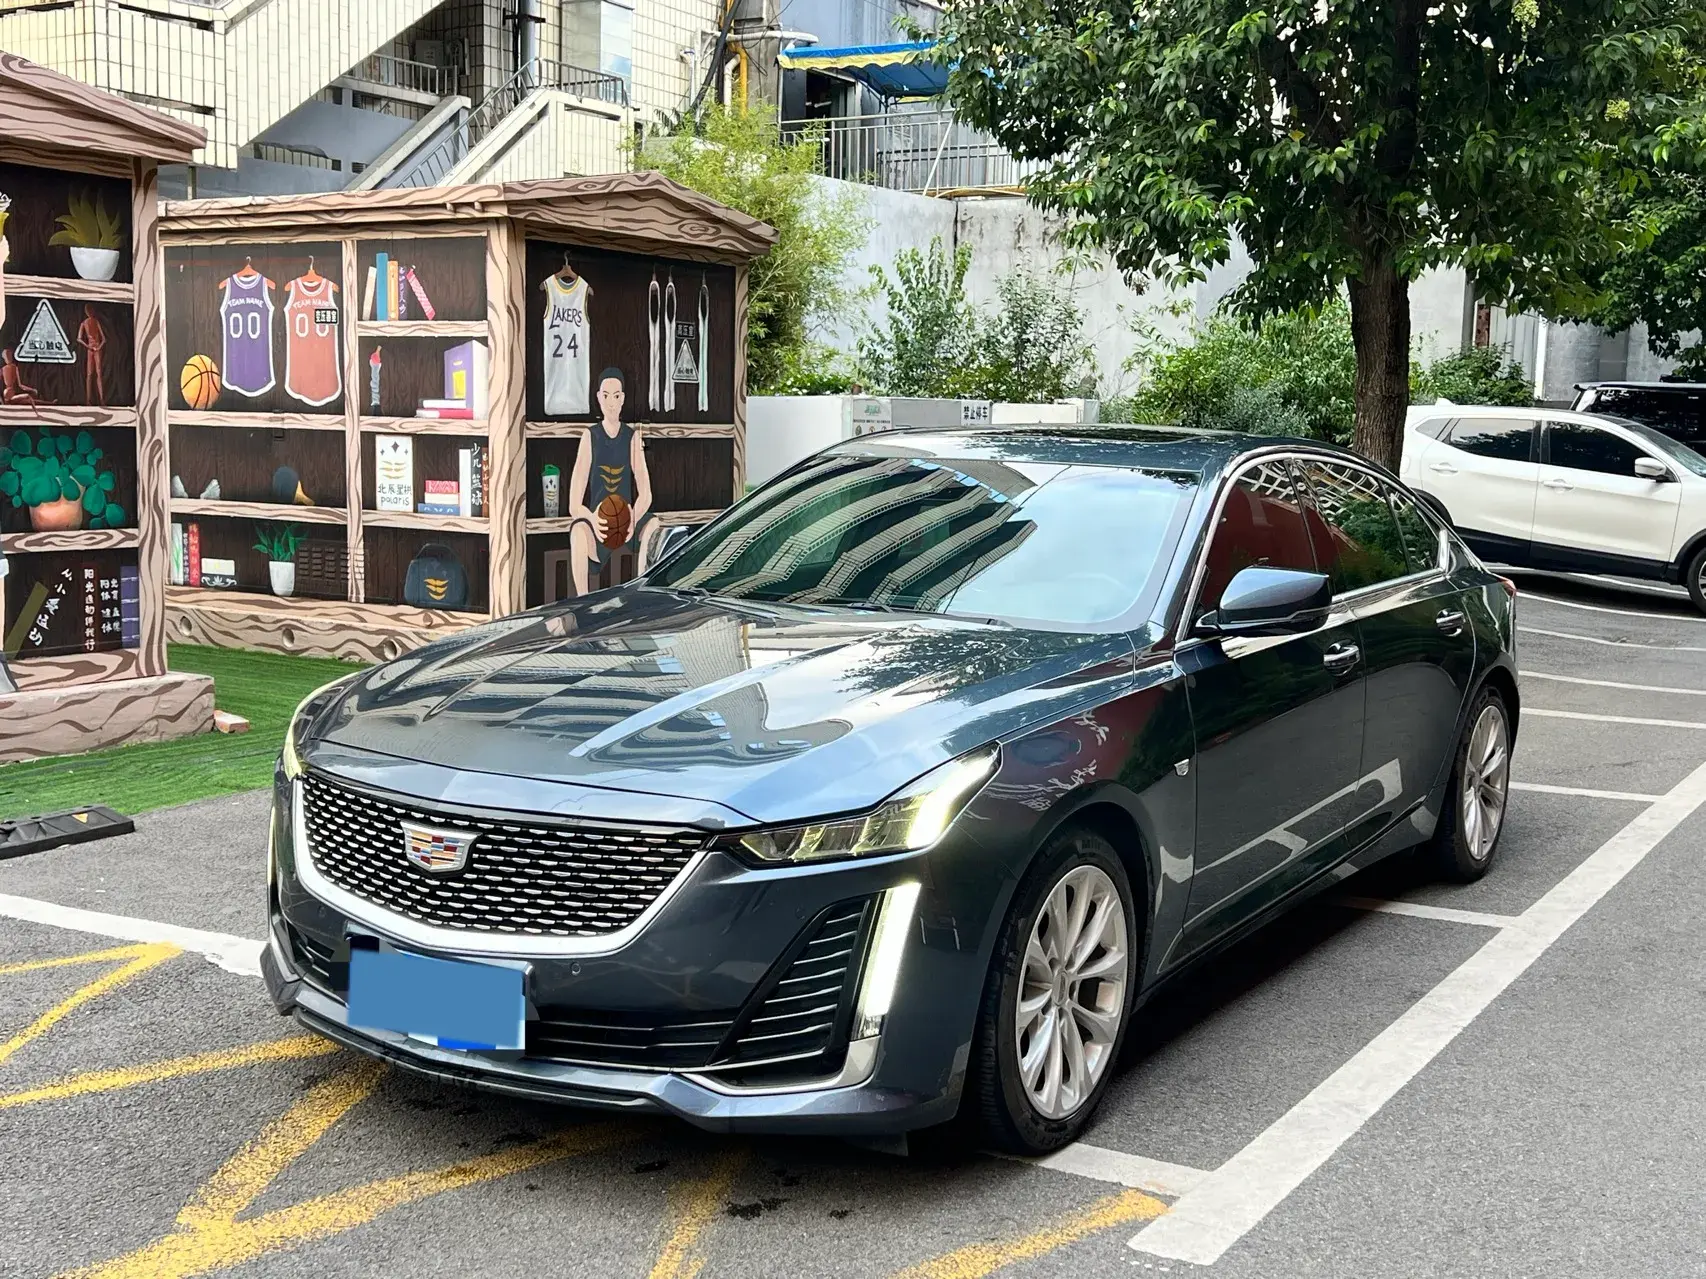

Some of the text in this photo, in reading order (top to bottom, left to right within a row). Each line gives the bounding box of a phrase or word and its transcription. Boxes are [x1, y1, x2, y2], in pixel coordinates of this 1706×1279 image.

[228, 297, 264, 308] TEAM NAME
[293, 298, 310, 309] TEAM
[315, 309, 337, 322] 变压器室
[549, 304, 582, 330] LAKERS
[230, 312, 260, 339] 00
[552, 333, 578, 358] 24
[963, 405, 988, 420] 禁止停车
[381, 496, 410, 507] polaris
[83, 568, 96, 651] 阳光运动伴我行
